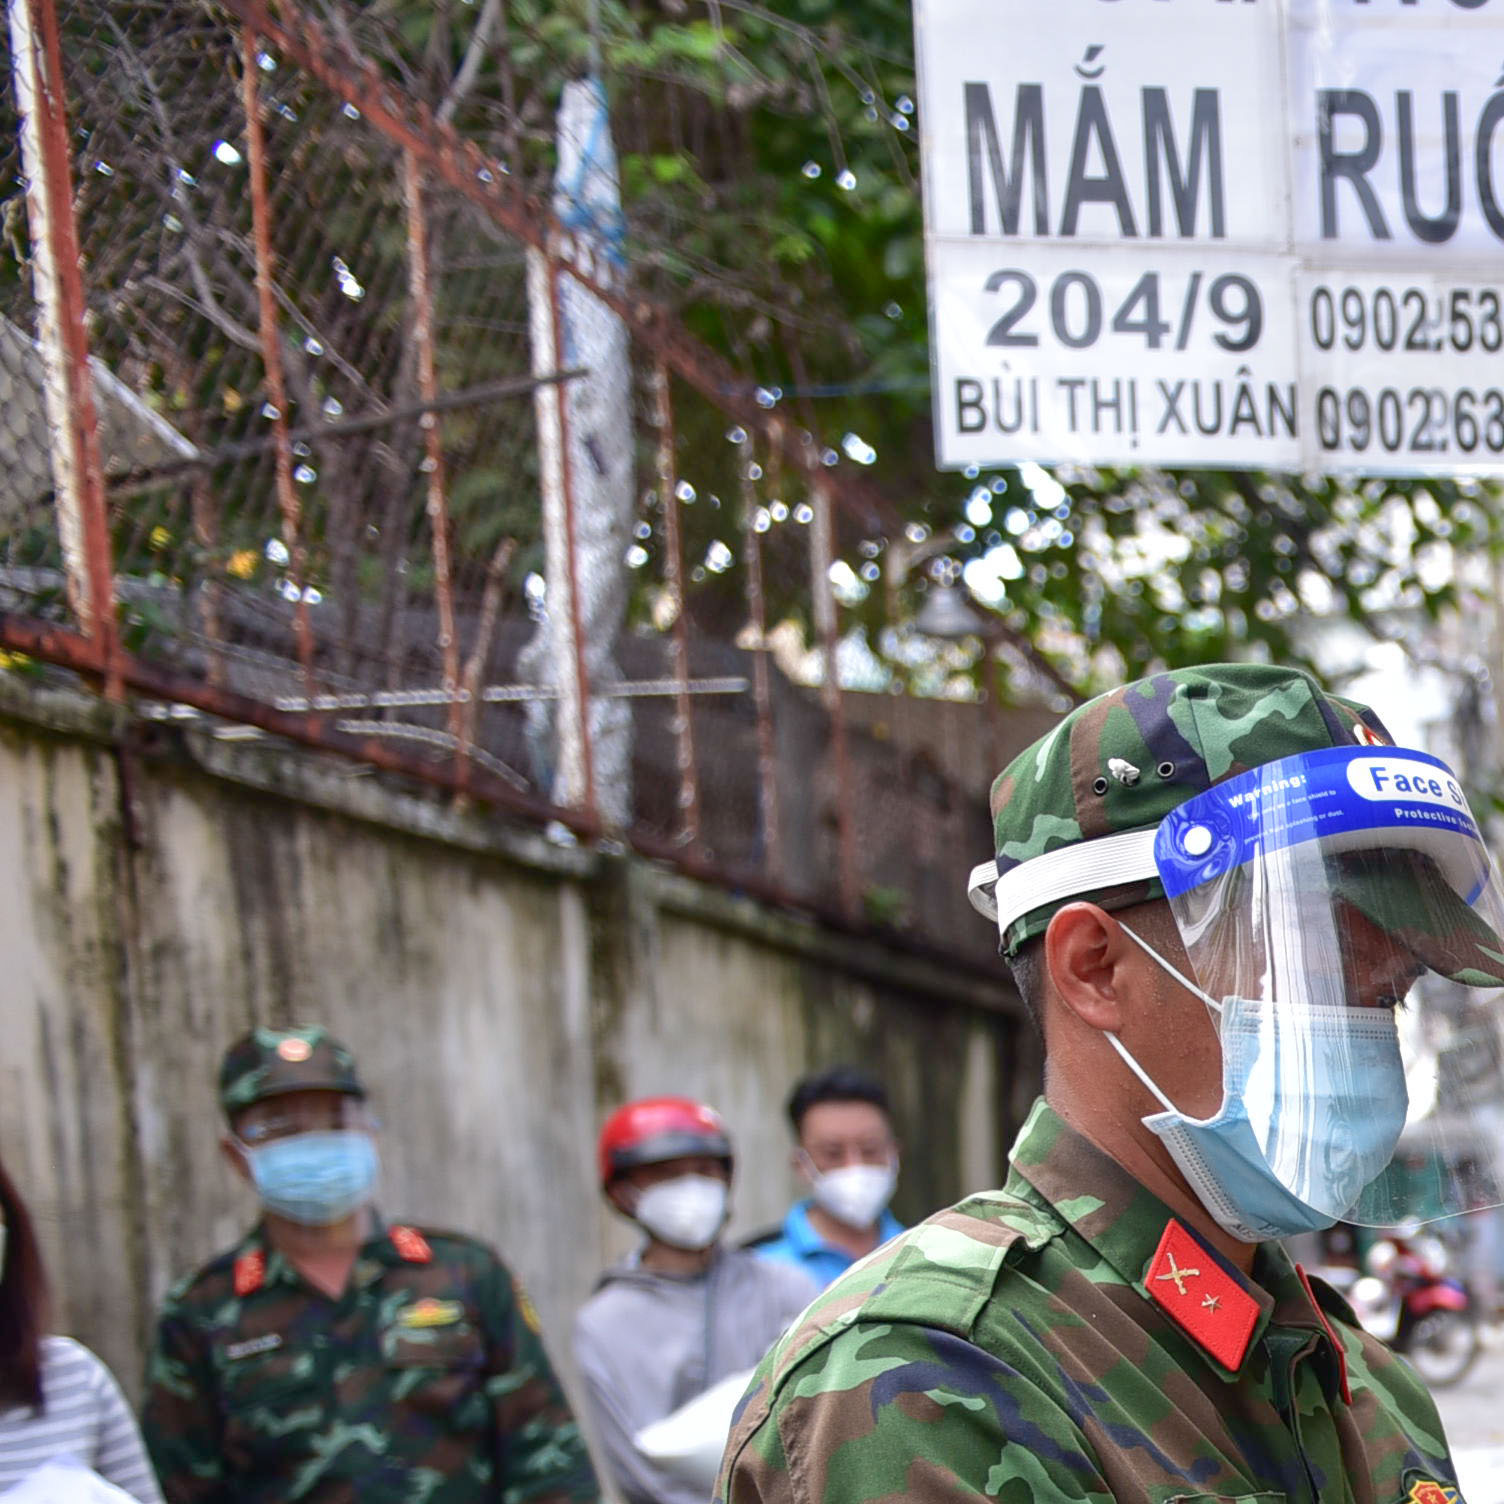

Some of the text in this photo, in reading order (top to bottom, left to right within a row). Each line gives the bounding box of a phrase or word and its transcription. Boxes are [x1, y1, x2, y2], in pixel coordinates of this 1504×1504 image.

[962, 44, 1226, 239] MẮM
[983, 269, 1263, 352] 204/9
[955, 361, 1298, 449] BÙI THỊ XUÂN
[1228, 774, 1307, 808] Warning:
[1308, 790, 1329, 800] shield
[1369, 766, 1443, 798] Face
[1394, 807, 1457, 825] Protective
